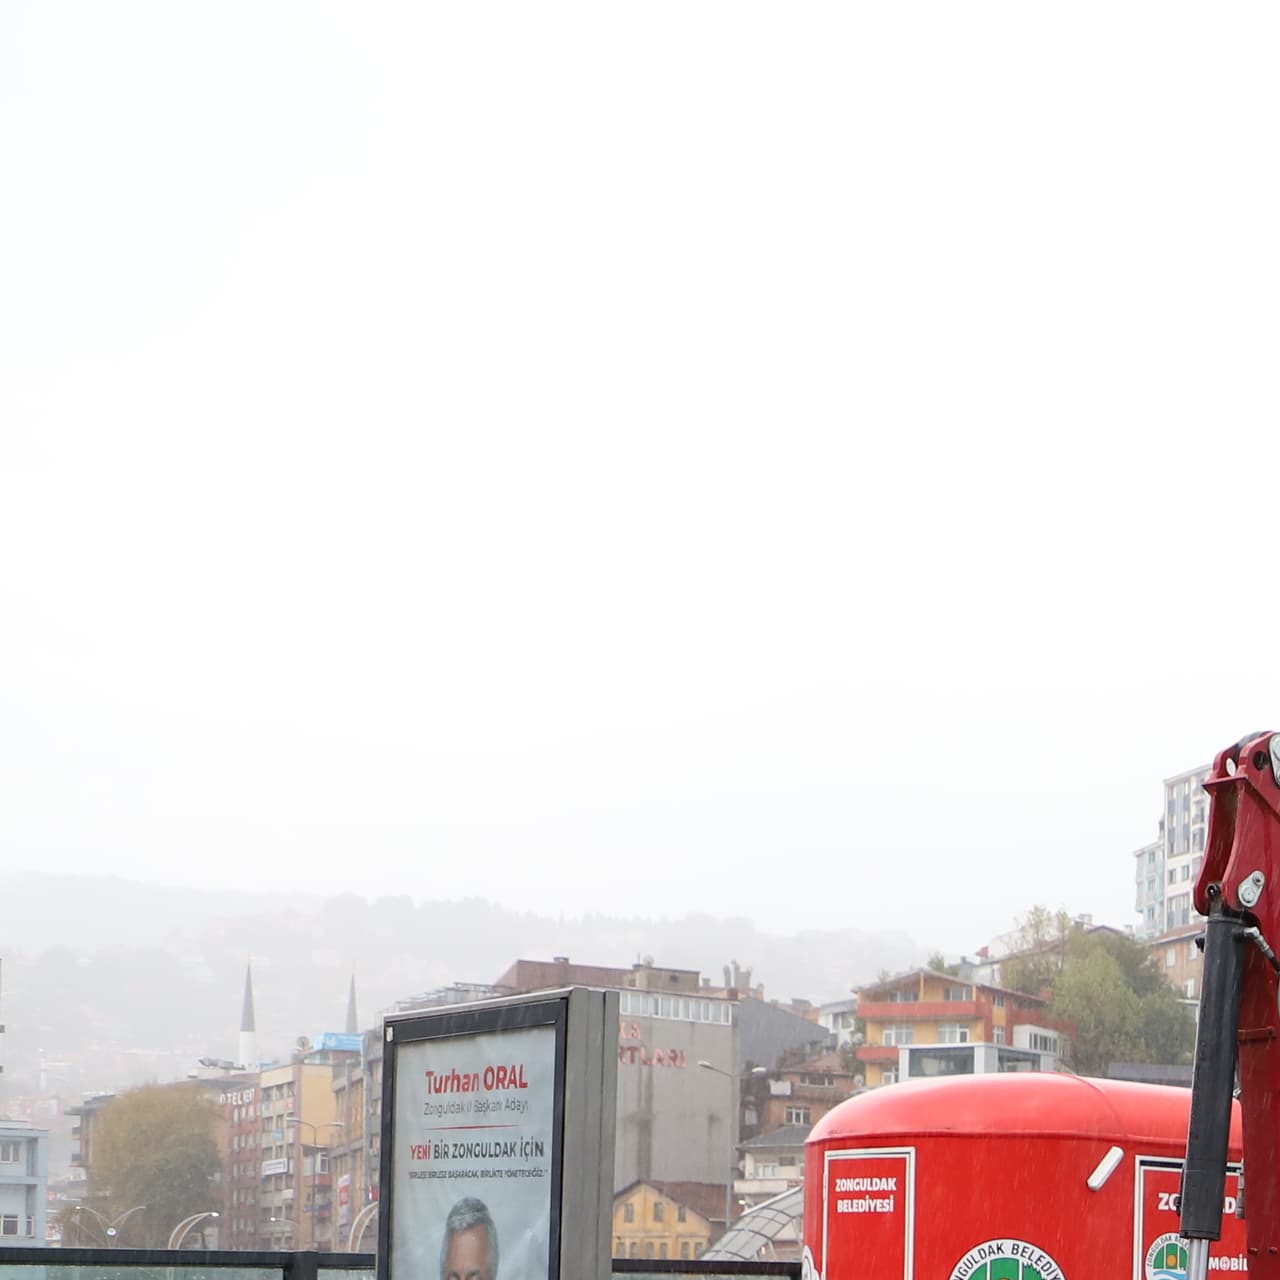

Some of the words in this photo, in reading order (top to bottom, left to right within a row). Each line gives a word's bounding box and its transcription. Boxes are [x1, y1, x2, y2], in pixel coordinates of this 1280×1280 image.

[425, 1068, 480, 1095] Turhan
[483, 1064, 529, 1092] ORAL
[424, 1102, 465, 1118] Zonguldak
[410, 1139, 431, 1160] YENİ
[433, 1138, 450, 1159] BİR
[451, 1141, 517, 1159] ZONGULDAK
[519, 1136, 545, 1161] İÇİN
[835, 1178, 897, 1193] ZONGULDAK
[837, 1195, 895, 1213] BELEDİYESİ
